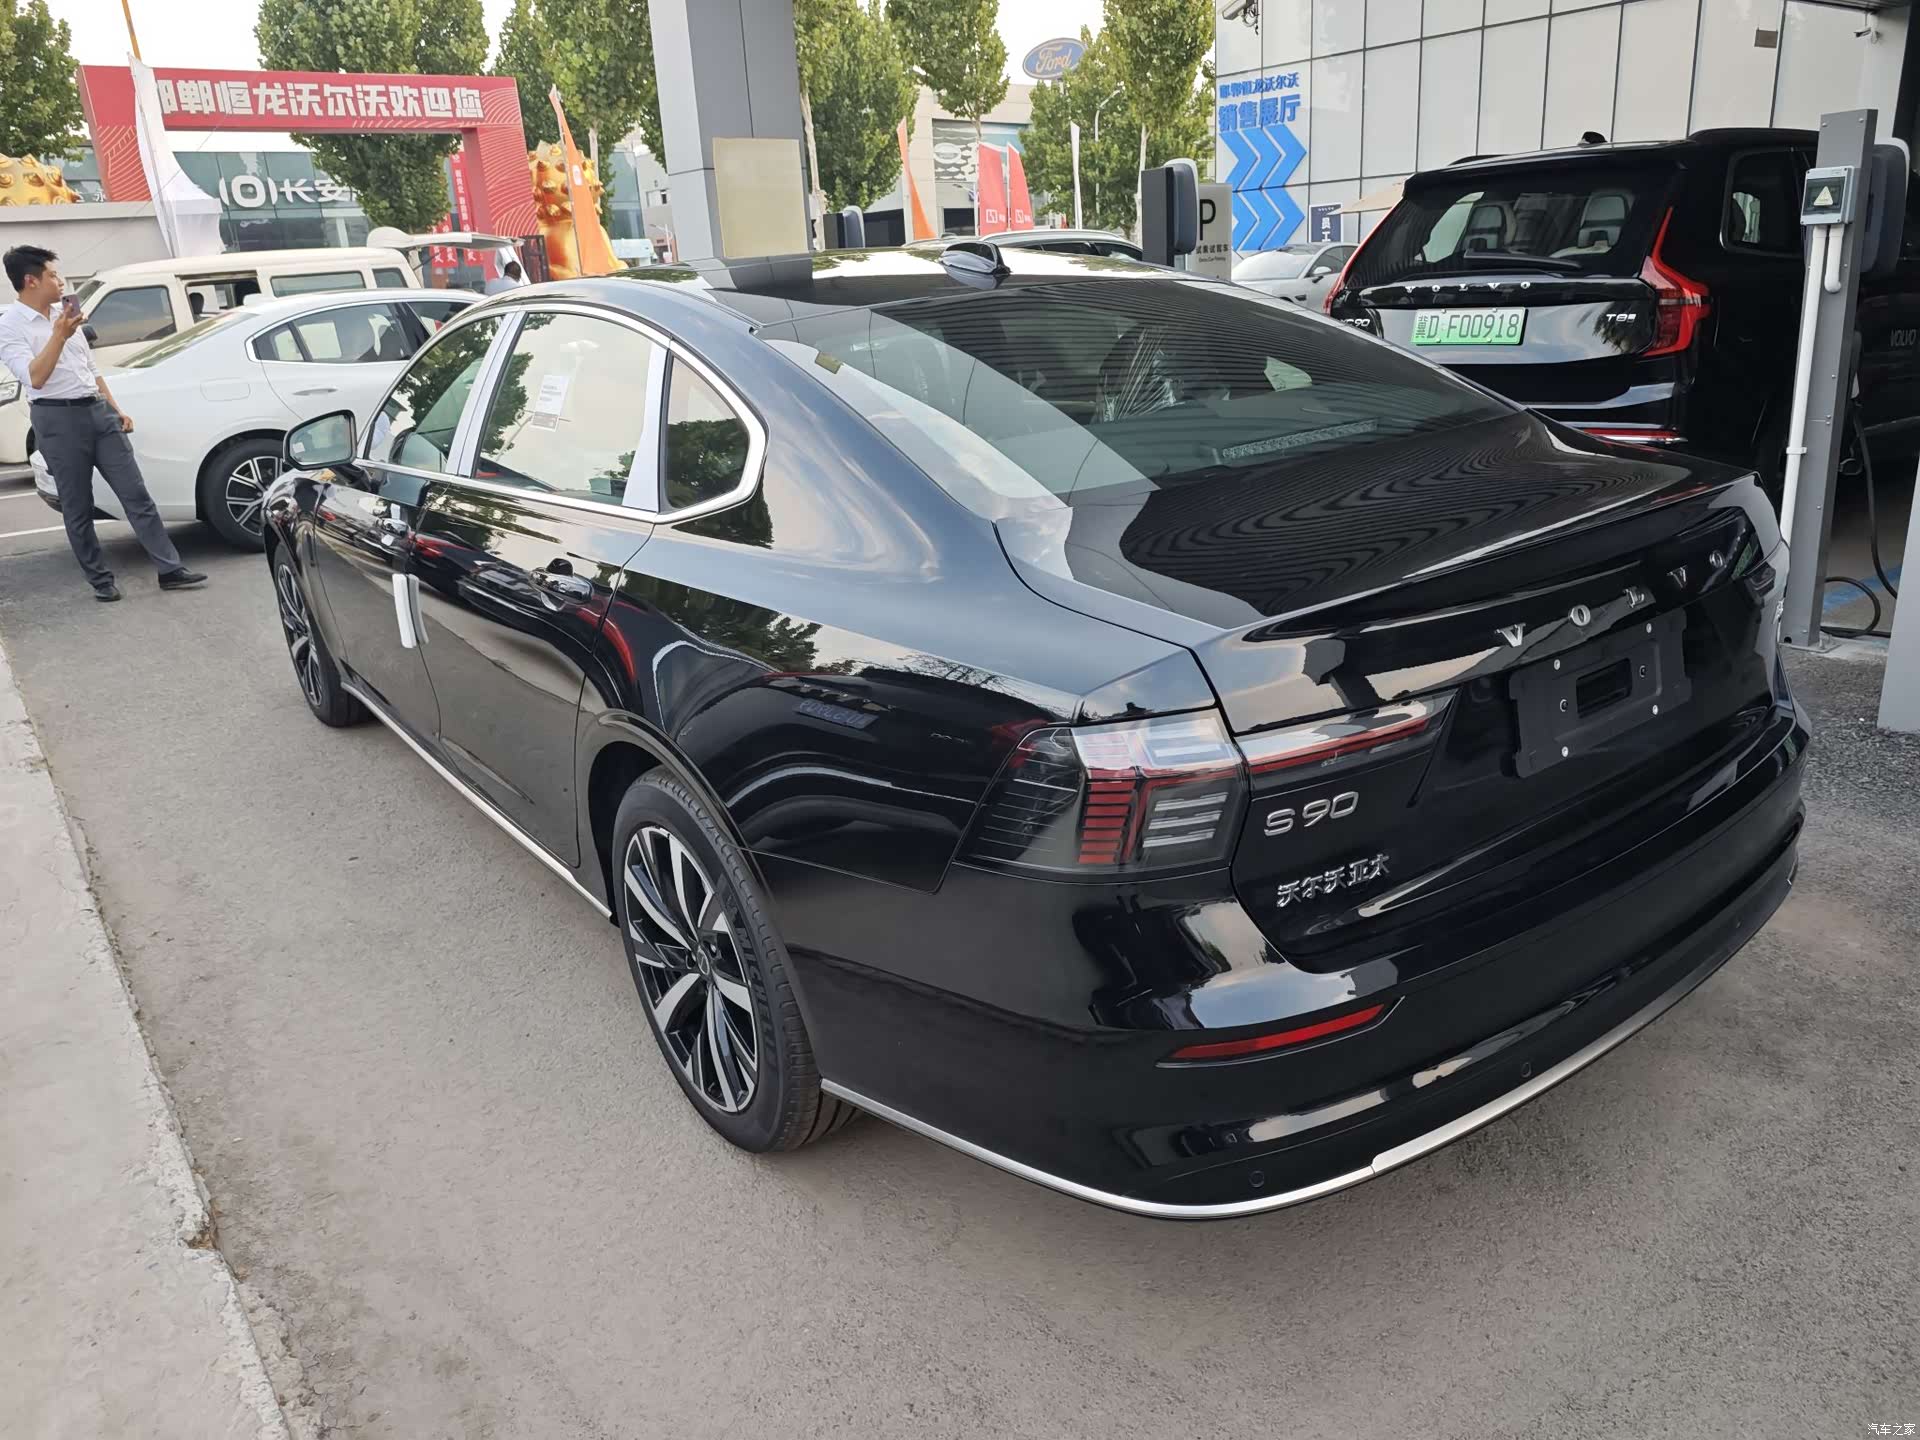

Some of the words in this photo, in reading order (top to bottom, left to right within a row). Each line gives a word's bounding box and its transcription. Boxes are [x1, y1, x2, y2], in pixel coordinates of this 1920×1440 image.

[1036, 45, 1073, 74] Ford
[1219, 94, 1301, 131] 销售展厅
[1200, 199, 1216, 241] P
[1405, 282, 1531, 294] VOLVO
[1495, 550, 1725, 648] VOLVO
[1276, 853, 1390, 908] 沃尔沃亚太
